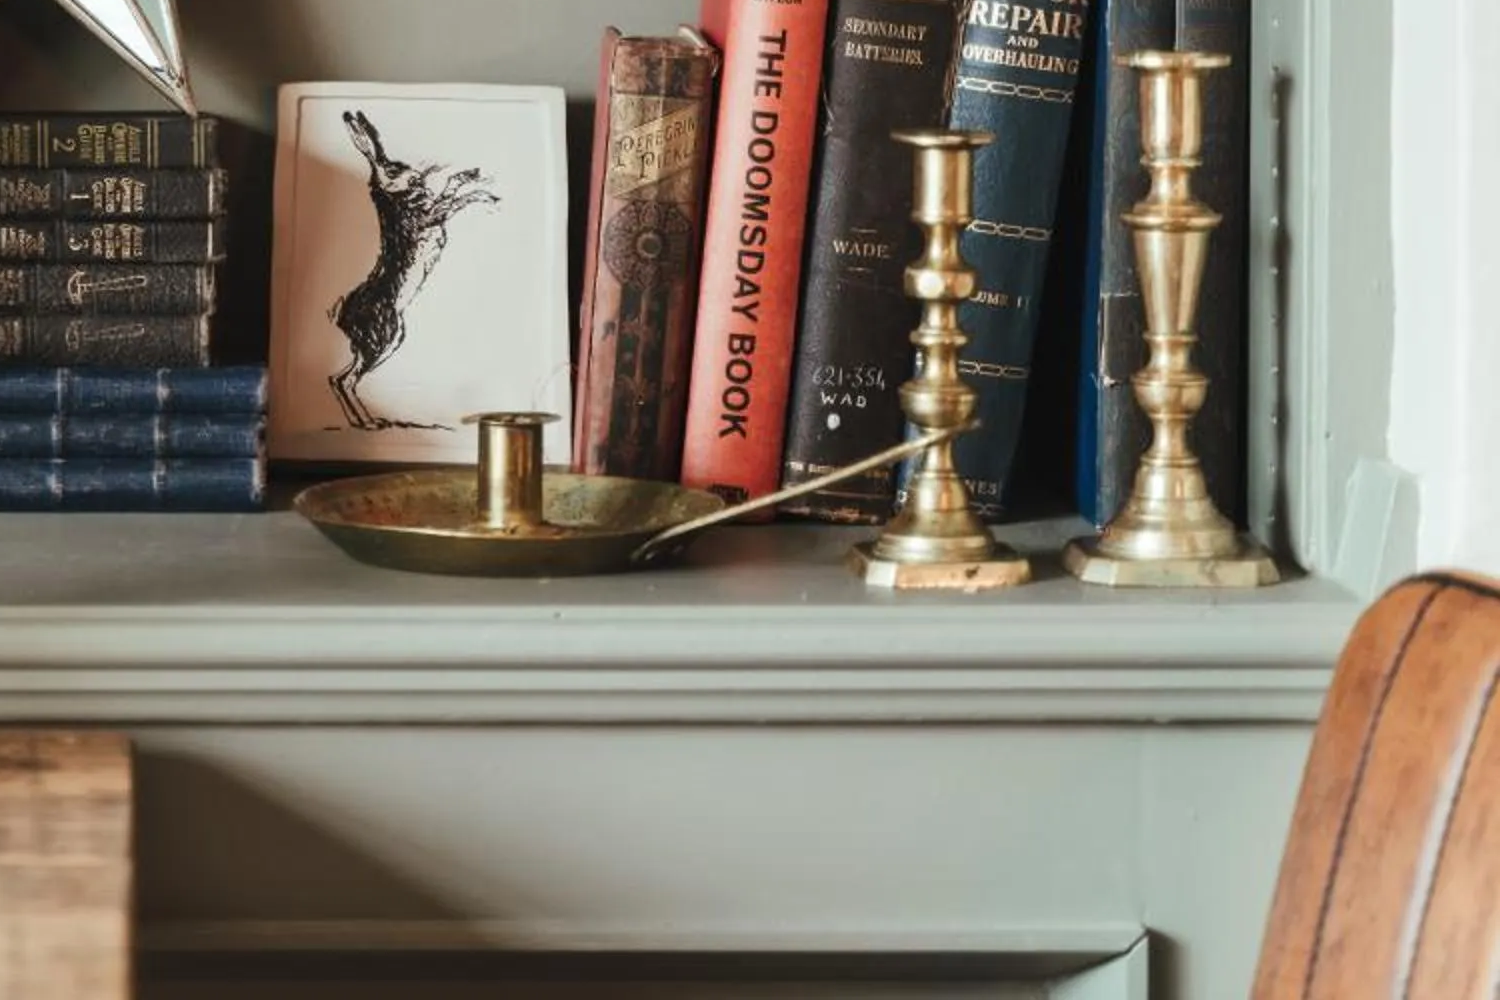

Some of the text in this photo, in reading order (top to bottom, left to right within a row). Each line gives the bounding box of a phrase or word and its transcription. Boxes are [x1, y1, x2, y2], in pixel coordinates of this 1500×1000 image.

[843, 16, 927, 42] SECONDARY
[967, 0, 1084, 39] REPAIR
[1006, 34, 1040, 49] AND
[753, 29, 787, 100] THE
[961, 43, 1080, 76] OVERHAULING
[53, 137, 76, 152] 2
[612, 115, 696, 169] PEREGRIN
[636, 144, 692, 179] PICKL
[731, 112, 779, 324] DOOMSDAY
[831, 239, 892, 260] WADE
[719, 333, 757, 441] BOOK
[819, 390, 868, 409] WAD
[963, 477, 999, 497] NES
